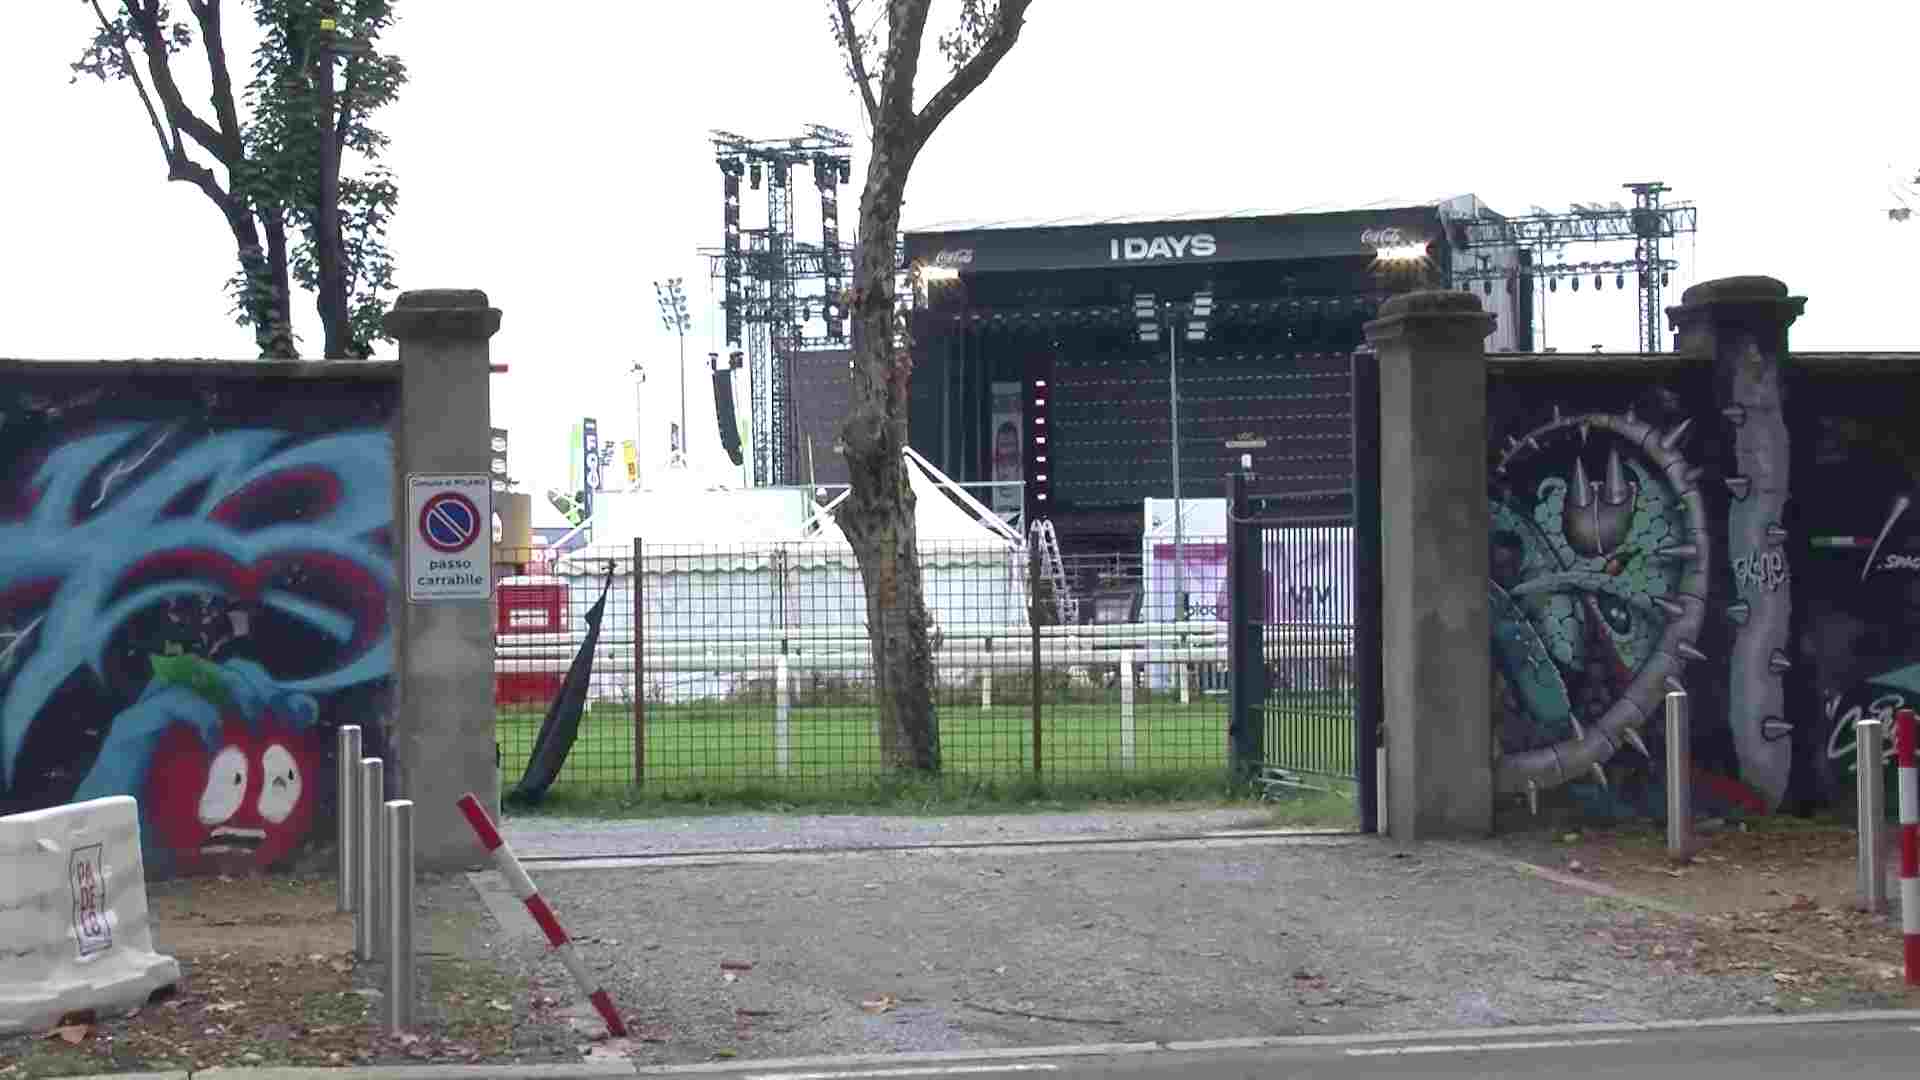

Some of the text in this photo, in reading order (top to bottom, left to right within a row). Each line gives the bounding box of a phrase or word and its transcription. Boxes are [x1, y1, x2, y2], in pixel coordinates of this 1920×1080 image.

[1124, 233, 1217, 259] DAYS
[430, 559, 472, 571] passo
[417, 573, 484, 586] carrabile
